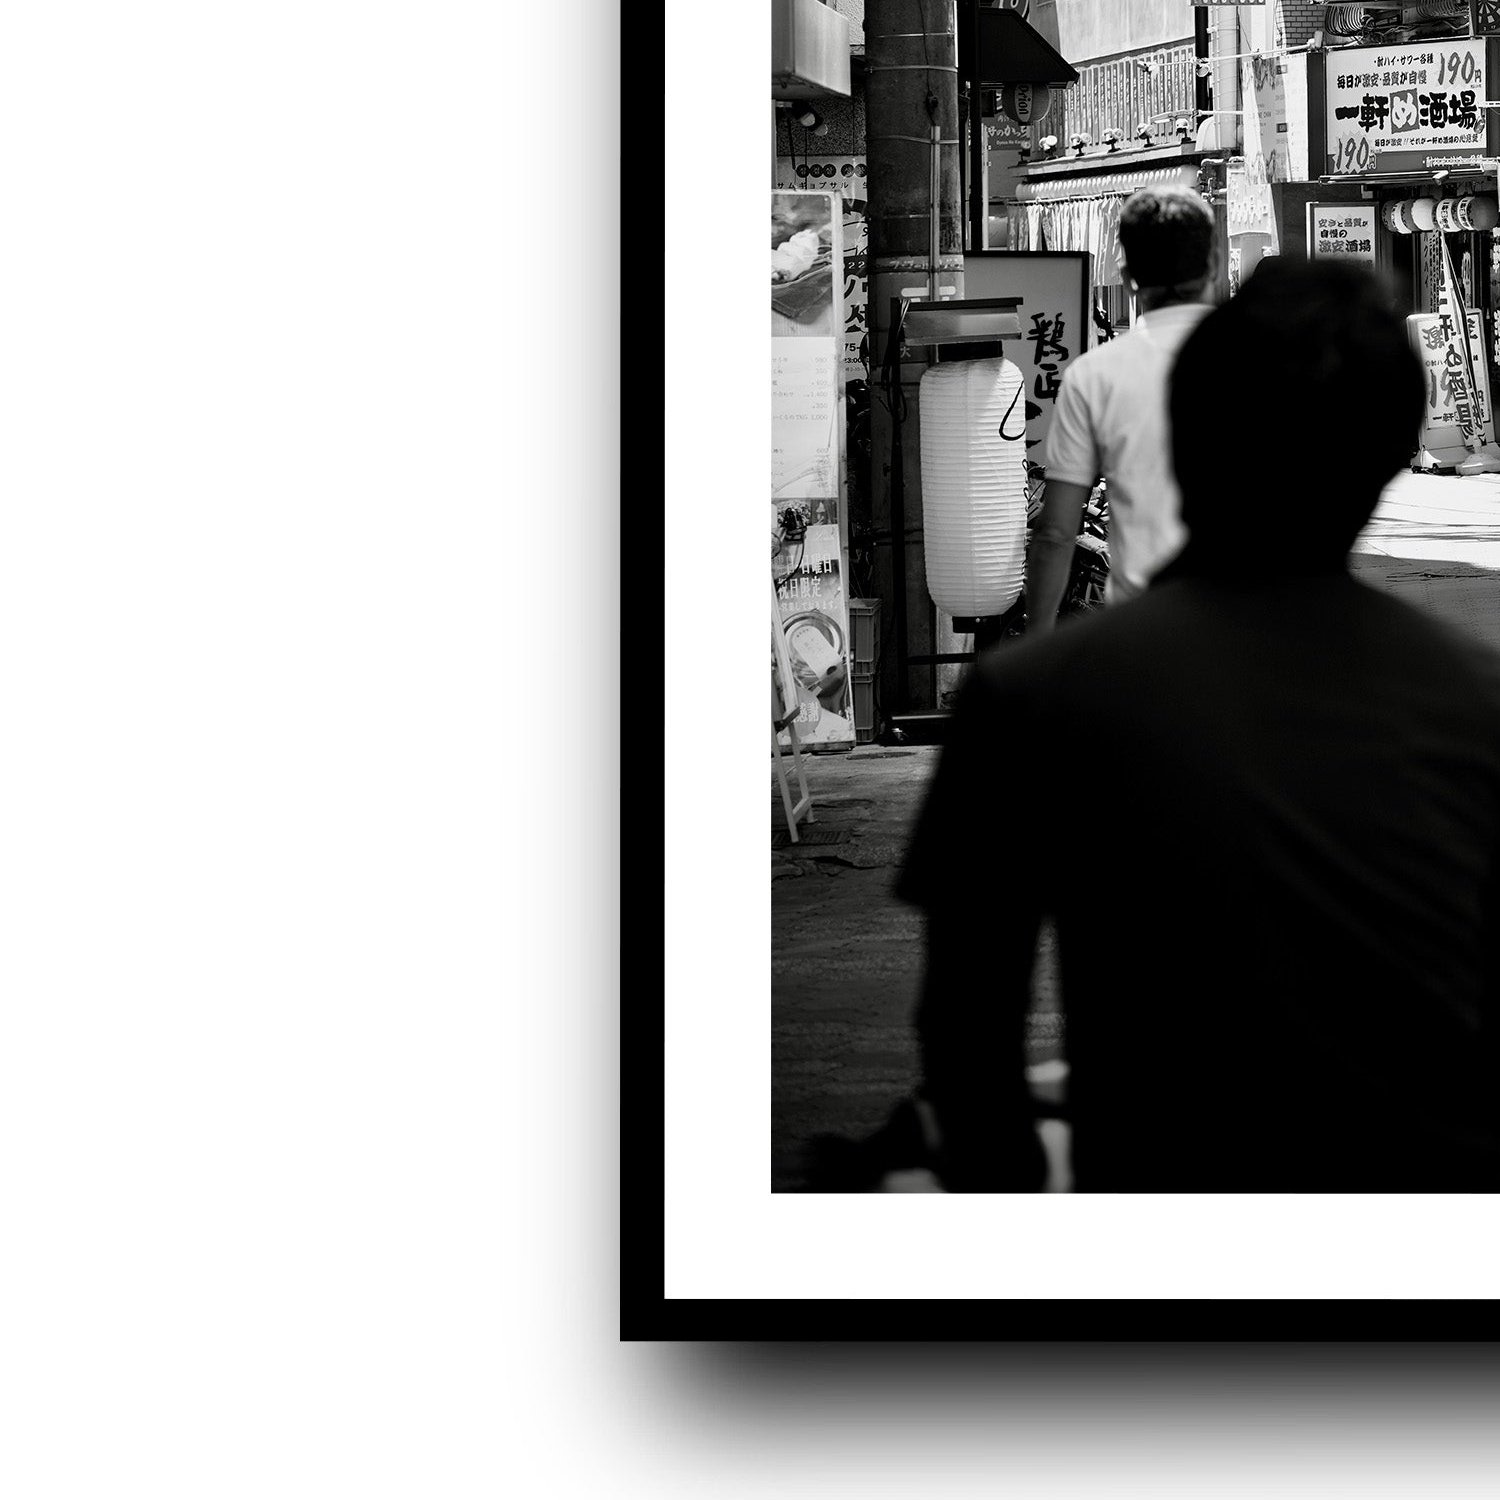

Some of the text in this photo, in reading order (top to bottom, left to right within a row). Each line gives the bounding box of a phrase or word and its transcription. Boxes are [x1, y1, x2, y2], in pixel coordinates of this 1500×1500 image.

[1334, 88, 1478, 134] 一軒め酒場
[1320, 228, 1348, 239] 自慢の
[1318, 239, 1371, 253] 激安酒場
